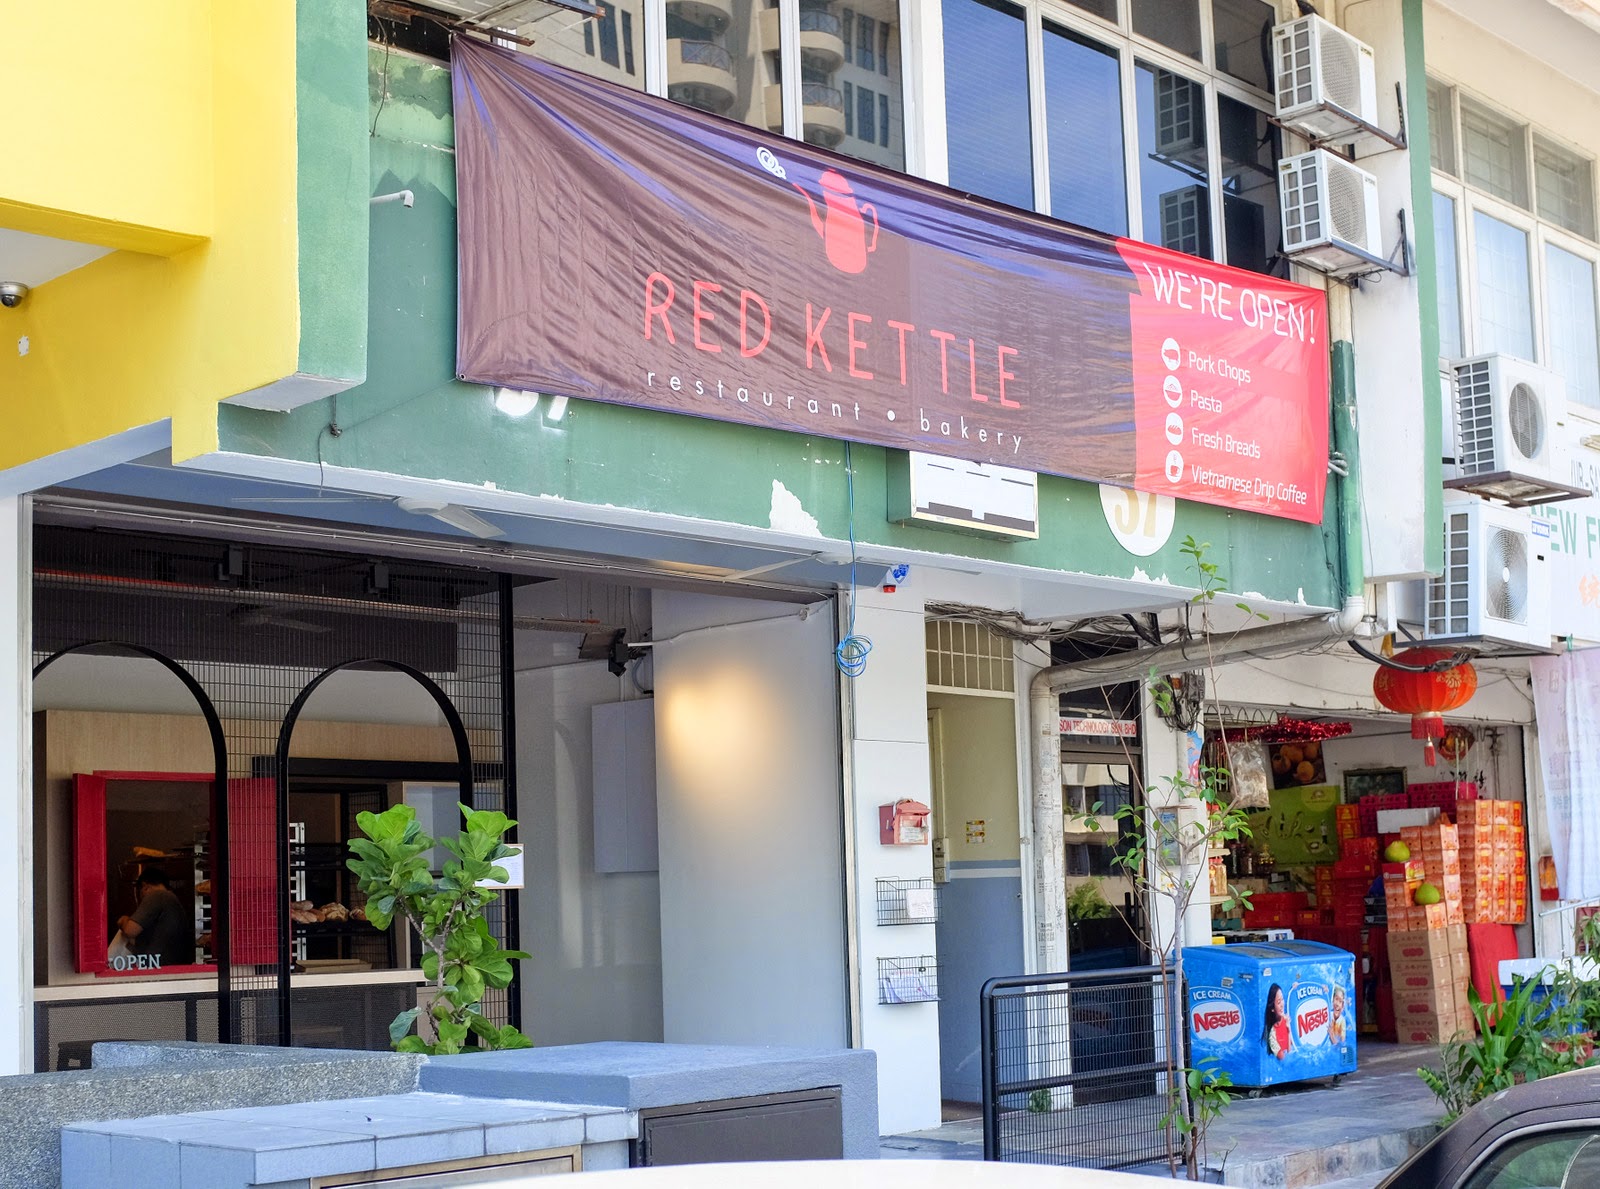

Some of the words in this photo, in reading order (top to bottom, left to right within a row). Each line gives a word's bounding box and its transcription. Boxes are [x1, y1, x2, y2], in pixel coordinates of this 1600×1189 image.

[1143, 262, 1233, 321] WE'RE
[644, 272, 772, 358] RED
[805, 302, 1021, 409] KETTLE
[1188, 350, 1215, 375] Pork
[1218, 357, 1251, 386] Chops
[647, 371, 861, 422] restaurant
[919, 408, 1023, 454] bakery
[1190, 389, 1222, 414] Pasta
[1191, 427, 1223, 450] Fresh
[1225, 435, 1261, 459] Breads
[1191, 464, 1252, 495] Vietnamese
[1254, 480, 1275, 504] Drip
[1277, 482, 1308, 505] Coffee
[1531, 504, 1577, 555] EW
[113, 953, 161, 971] OPEN
[1193, 992, 1207, 1000] ICE
[1208, 991, 1231, 1000] CREAM
[1297, 989, 1307, 999] ICE
[1307, 986, 1323, 996] CREAM
